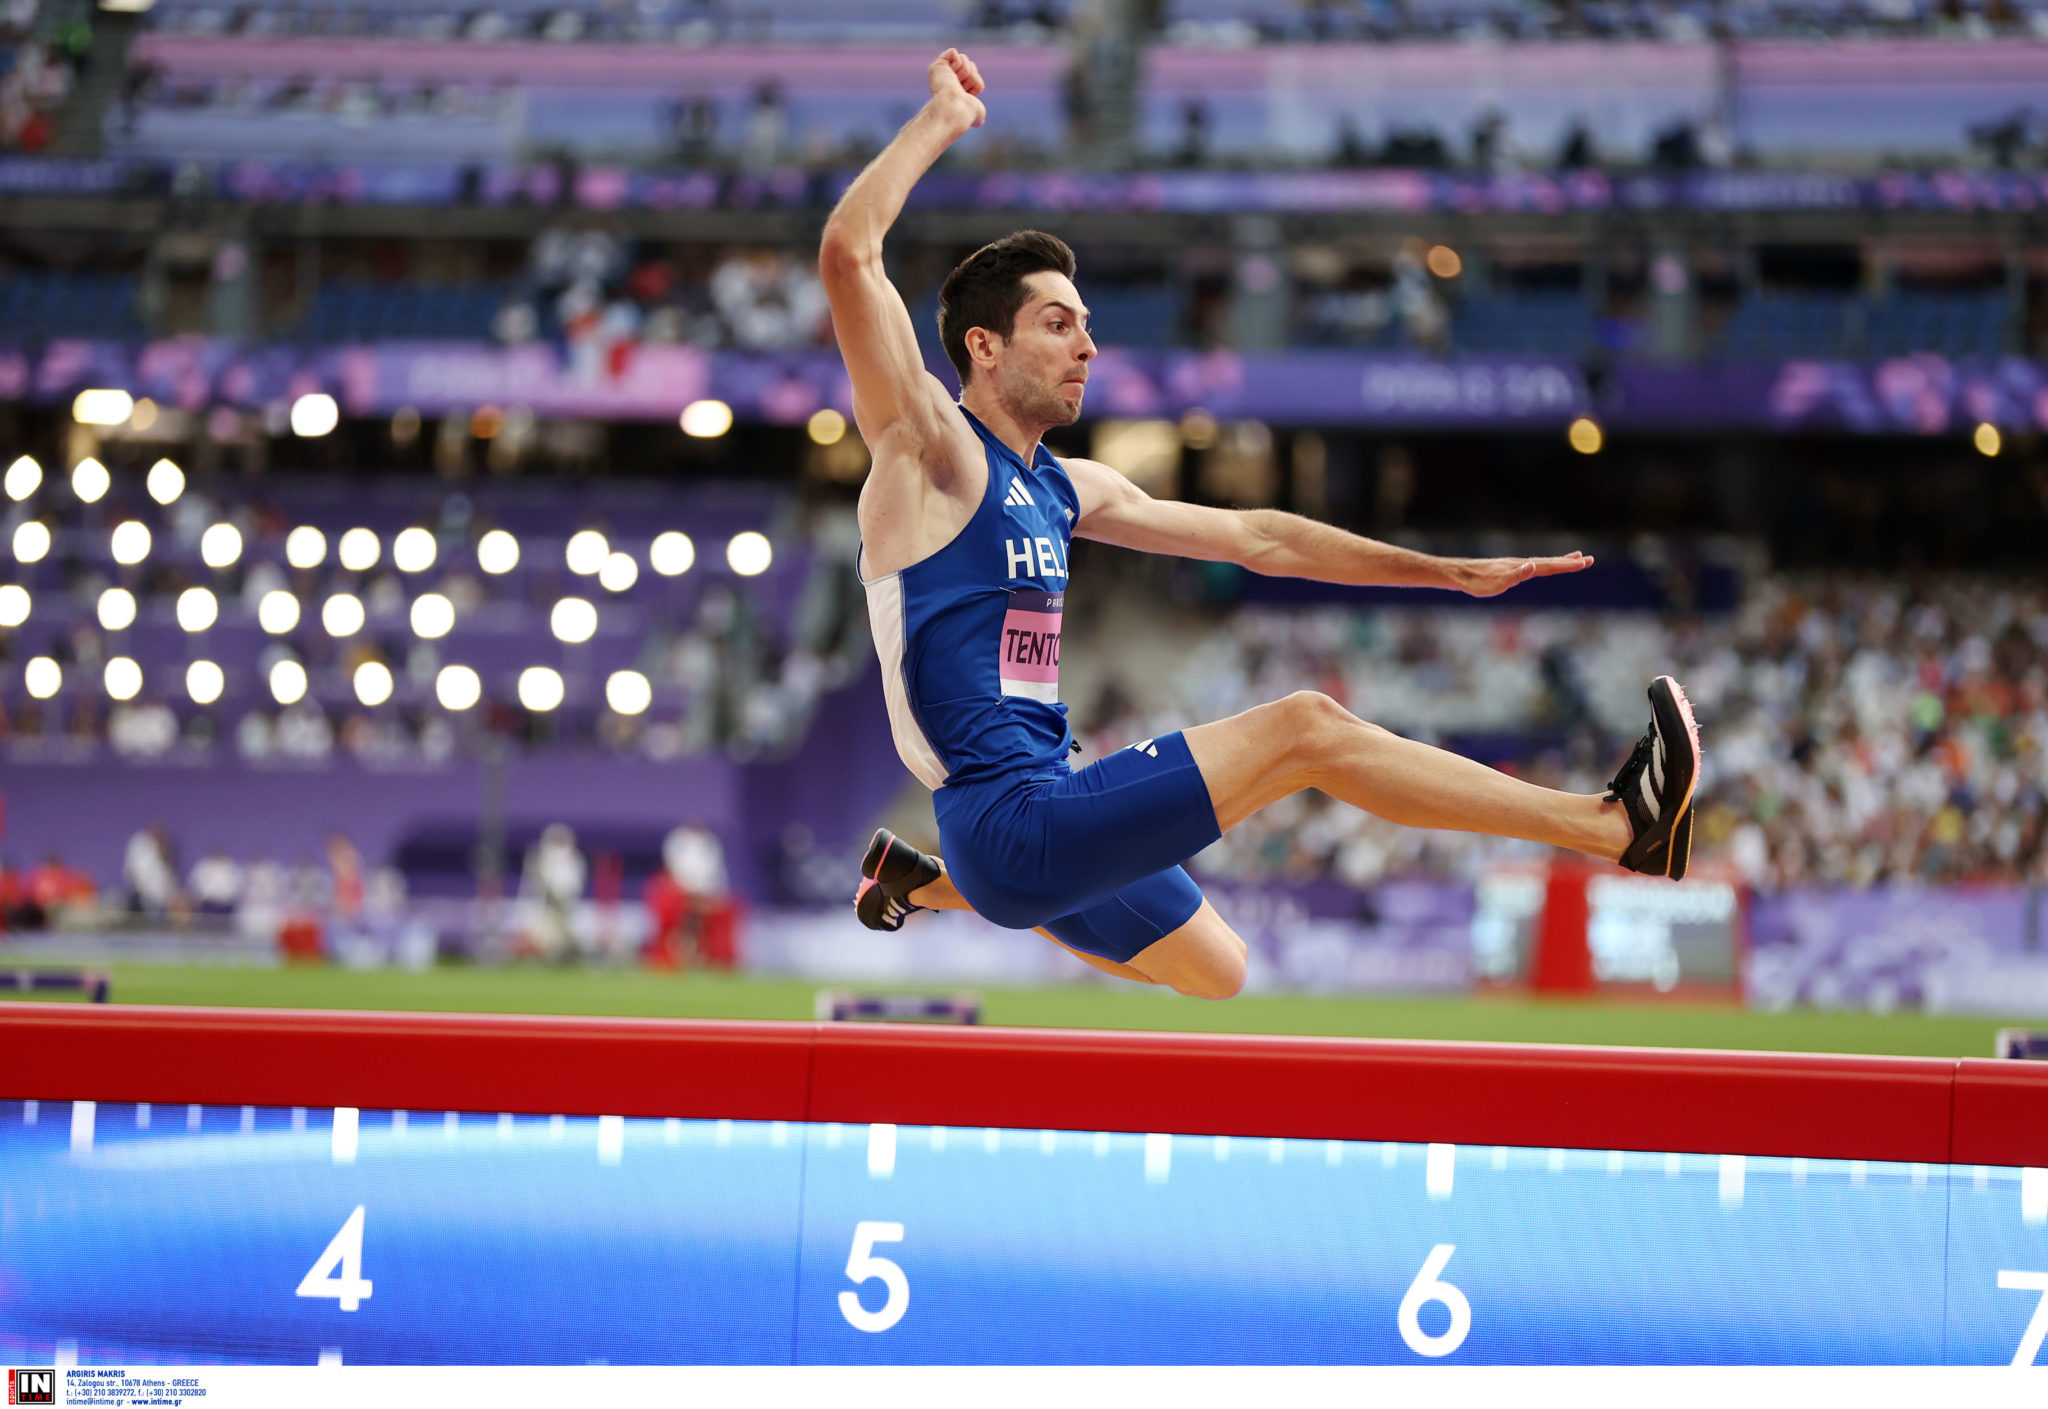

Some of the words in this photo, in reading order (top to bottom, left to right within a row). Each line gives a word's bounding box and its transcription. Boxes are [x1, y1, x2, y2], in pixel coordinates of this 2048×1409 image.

[295, 1204, 373, 1312] 4
[838, 1221, 911, 1333] 5
[1397, 1244, 1472, 1358] 6
[1997, 1269, 2048, 1366] 7
